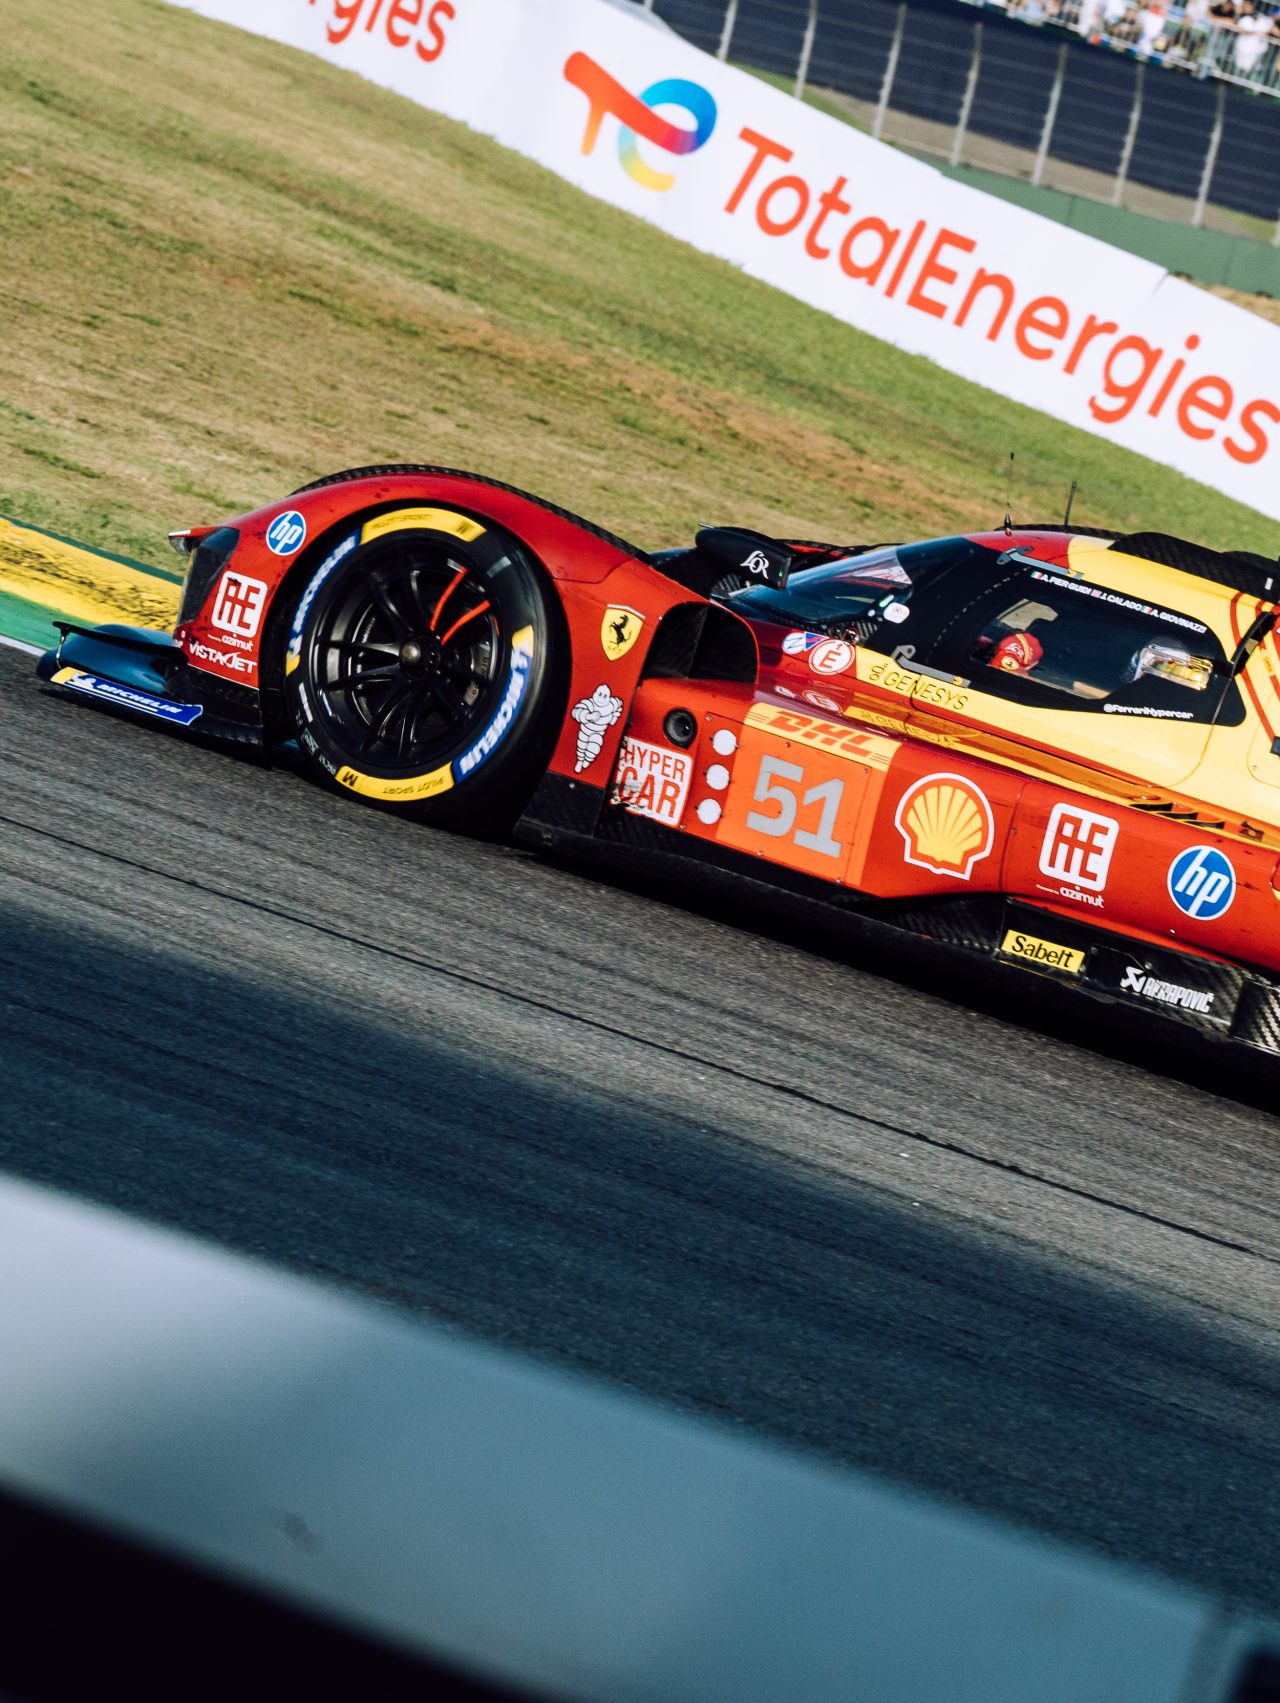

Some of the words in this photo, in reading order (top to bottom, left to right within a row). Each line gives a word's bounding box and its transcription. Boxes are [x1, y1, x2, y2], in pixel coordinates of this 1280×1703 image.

[269, 512, 304, 554] hp
[189, 642, 257, 674] VISTAJET
[97, 684, 183, 714] MICHELIN
[883, 671, 969, 710] GENESYS
[767, 711, 874, 757] DHL
[624, 741, 686, 782] HYPER
[616, 766, 681, 819] CAR
[746, 754, 845, 859] 51
[1059, 885, 1105, 909] azimut
[1173, 848, 1231, 919] hp
[1011, 935, 1075, 968] Sabelt
